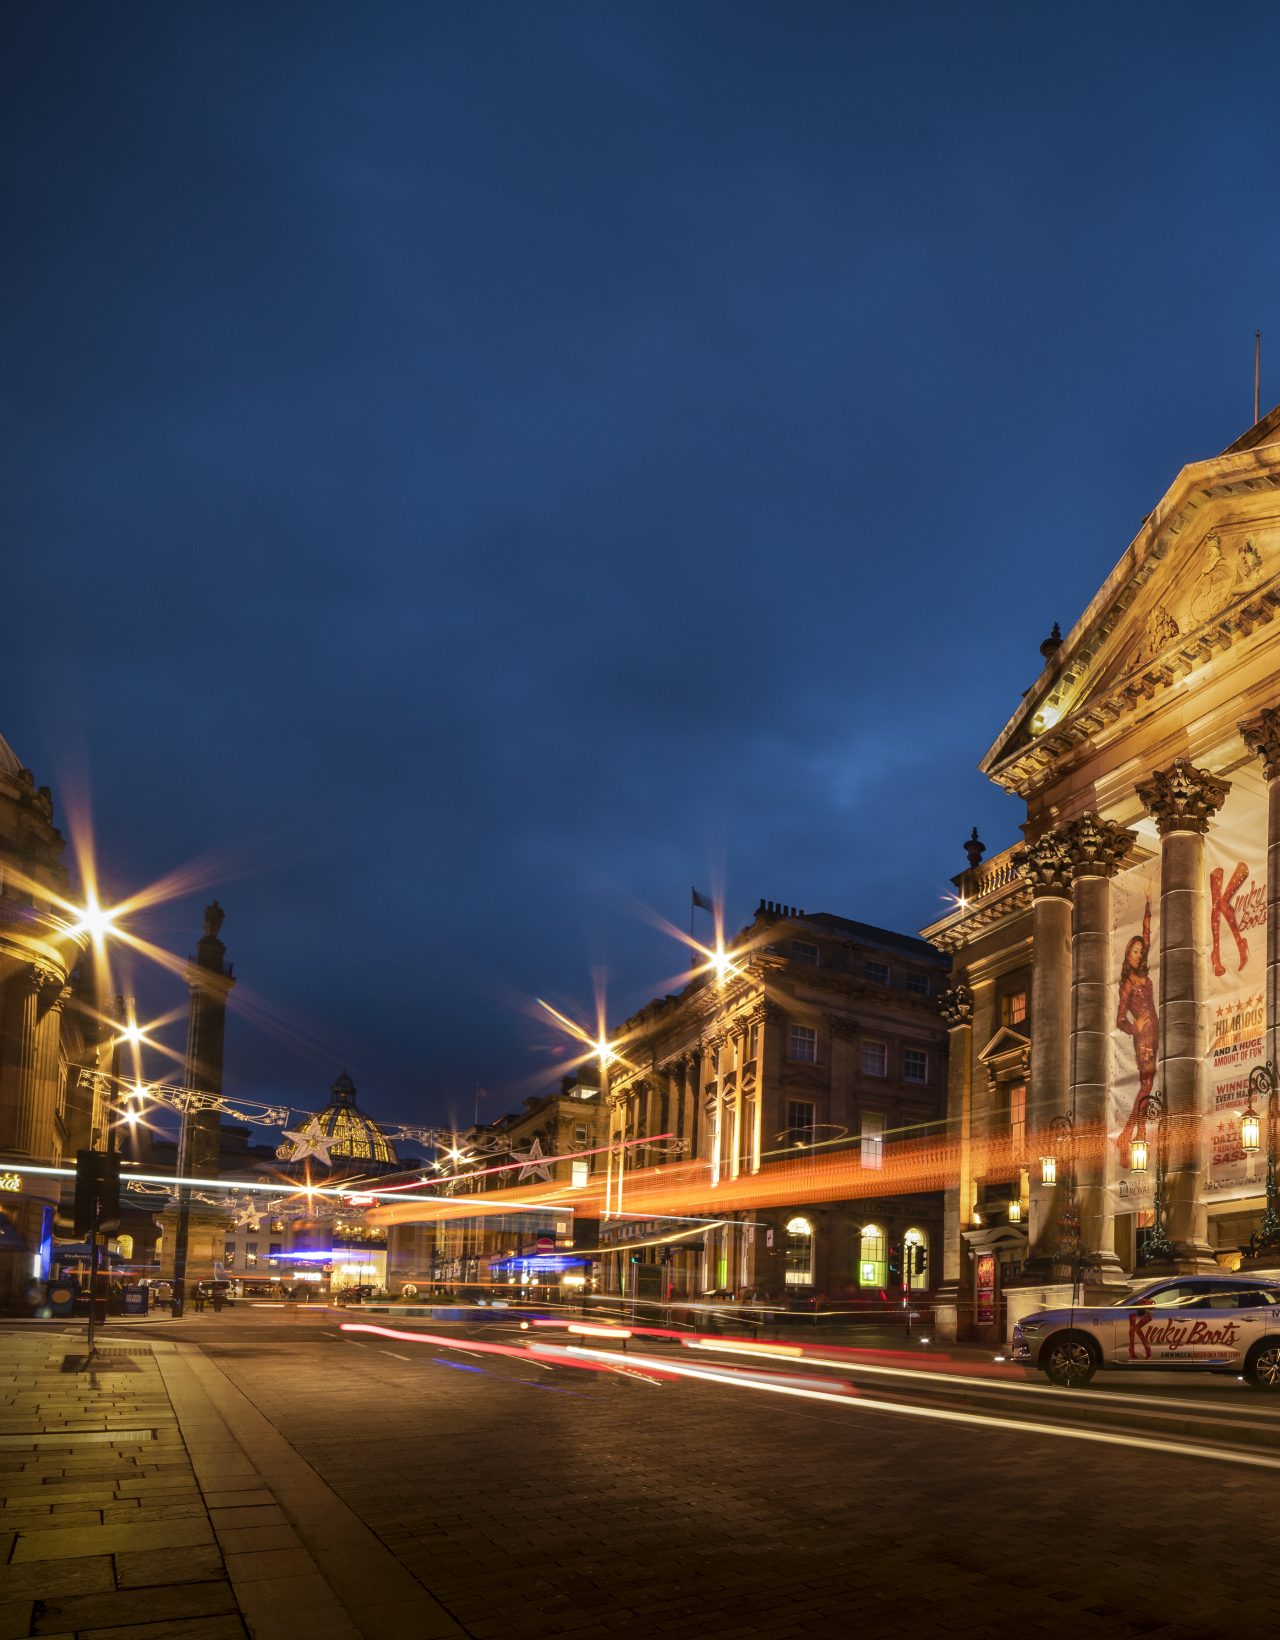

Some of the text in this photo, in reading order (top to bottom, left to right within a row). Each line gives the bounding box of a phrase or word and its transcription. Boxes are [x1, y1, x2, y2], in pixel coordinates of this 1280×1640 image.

[1214, 1037, 1262, 1058] AND A HUGE
[1214, 1051, 1239, 1068] AMOUNT
[1240, 1049, 1249, 1061] OF
[1216, 1093, 1235, 1104] EVERY
[1203, 1181, 1213, 1190] 29
[1213, 1178, 1230, 1189] OCT
[1246, 1173, 1263, 1184] NOV
[1128, 1312, 1241, 1359] Kinky Boots
